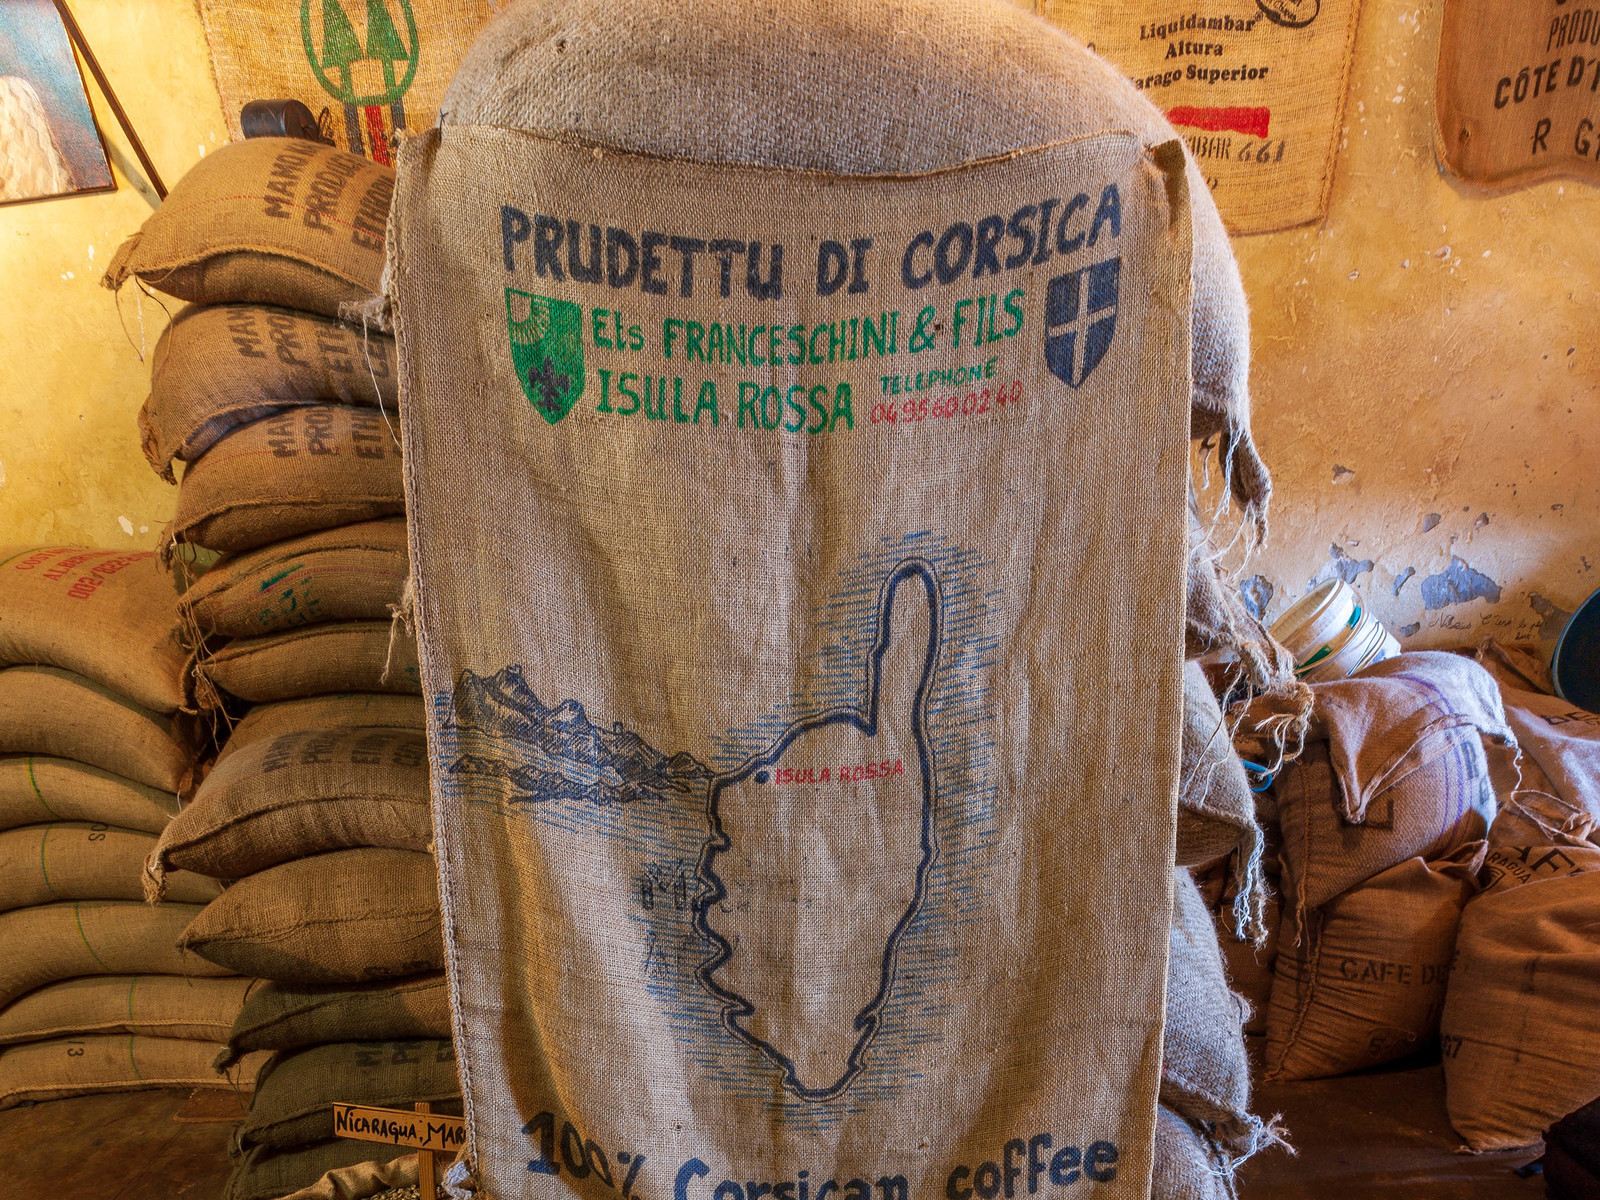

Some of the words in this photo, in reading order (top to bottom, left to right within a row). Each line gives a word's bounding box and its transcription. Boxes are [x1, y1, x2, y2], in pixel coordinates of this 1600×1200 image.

[1165, 41, 1223, 59] Altura
[1130, 68, 1182, 90] arago
[1186, 64, 1269, 84] Superior
[1494, 58, 1561, 109] CÔTE
[500, 205, 784, 301] PRUDETTU
[815, 238, 873, 297] DI
[901, 182, 1122, 290] CORSICA
[663, 311, 900, 368] FRANCESCHINI
[908, 305, 936, 354] &
[952, 289, 1026, 349] FILS
[879, 355, 999, 396] TELEPHONE
[596, 368, 720, 428] ISULA
[737, 381, 855, 435] ROSSA
[774, 766, 831, 785] ISULA
[838, 757, 905, 783] ROSSA
[1340, 959, 1412, 985] CAFE
